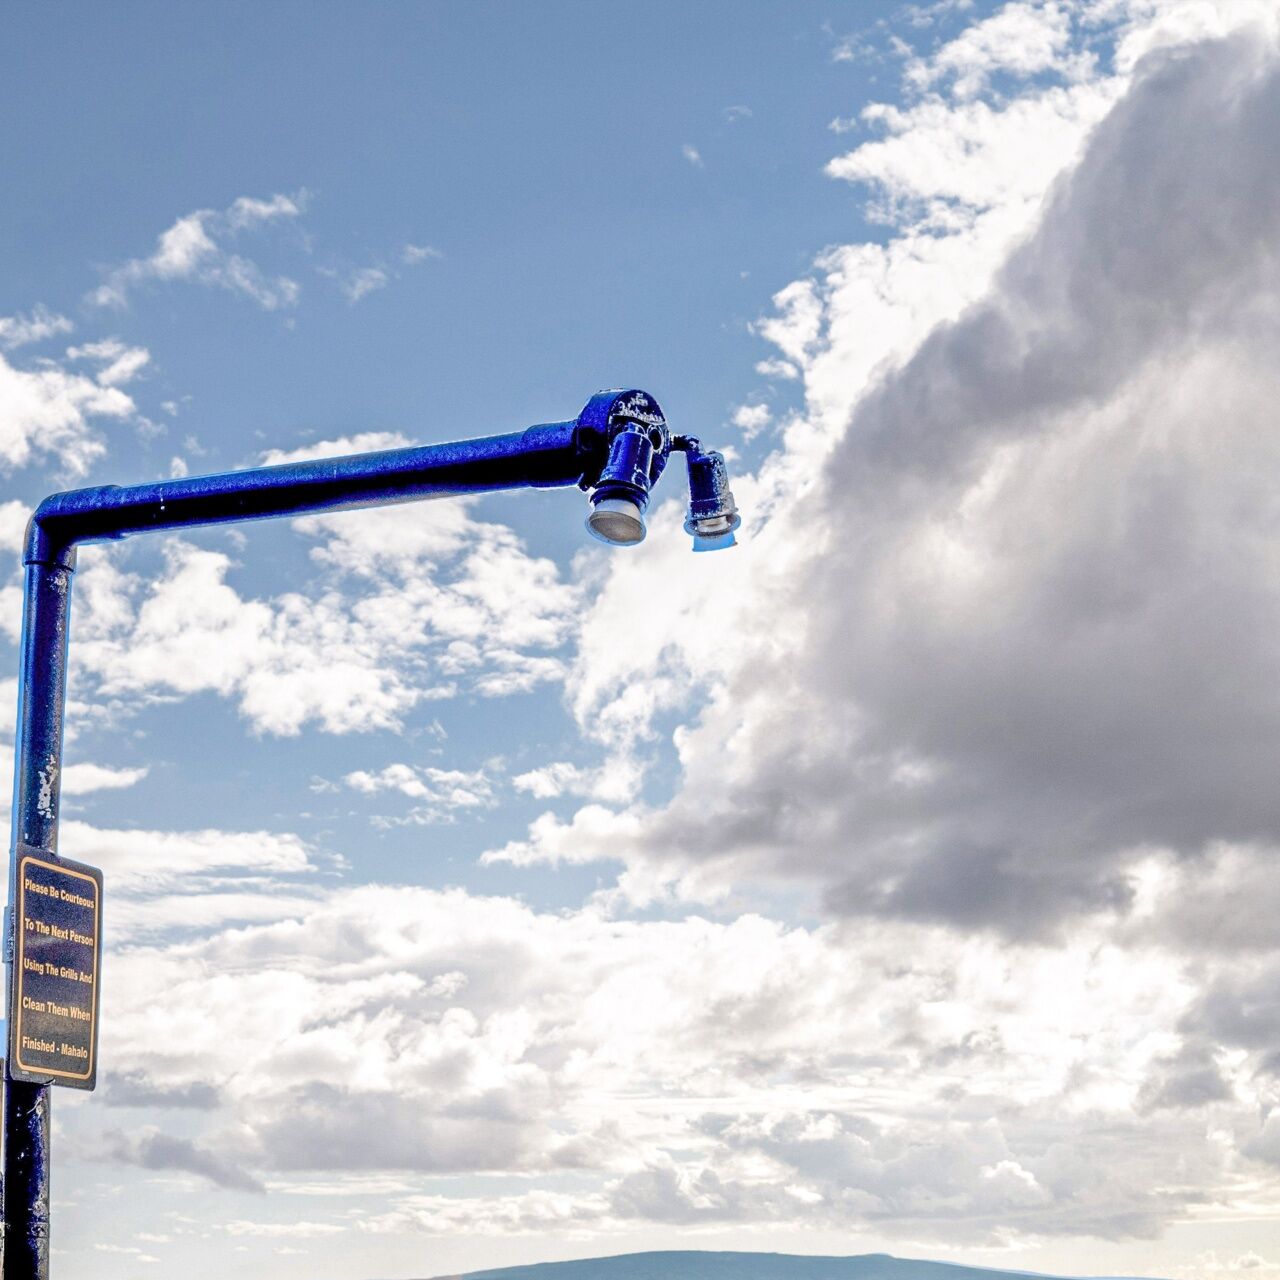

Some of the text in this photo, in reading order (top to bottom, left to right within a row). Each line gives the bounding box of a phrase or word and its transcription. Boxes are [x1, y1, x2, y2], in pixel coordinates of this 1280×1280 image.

[25, 879, 94, 909] Please Be Courteous
[24, 918, 94, 946] To The Next Person
[24, 957, 92, 984] Using The Grills And
[22, 996, 91, 1021] Clean Them When
[22, 1036, 55, 1053] Finished
[61, 1043, 88, 1059] Mahalo
